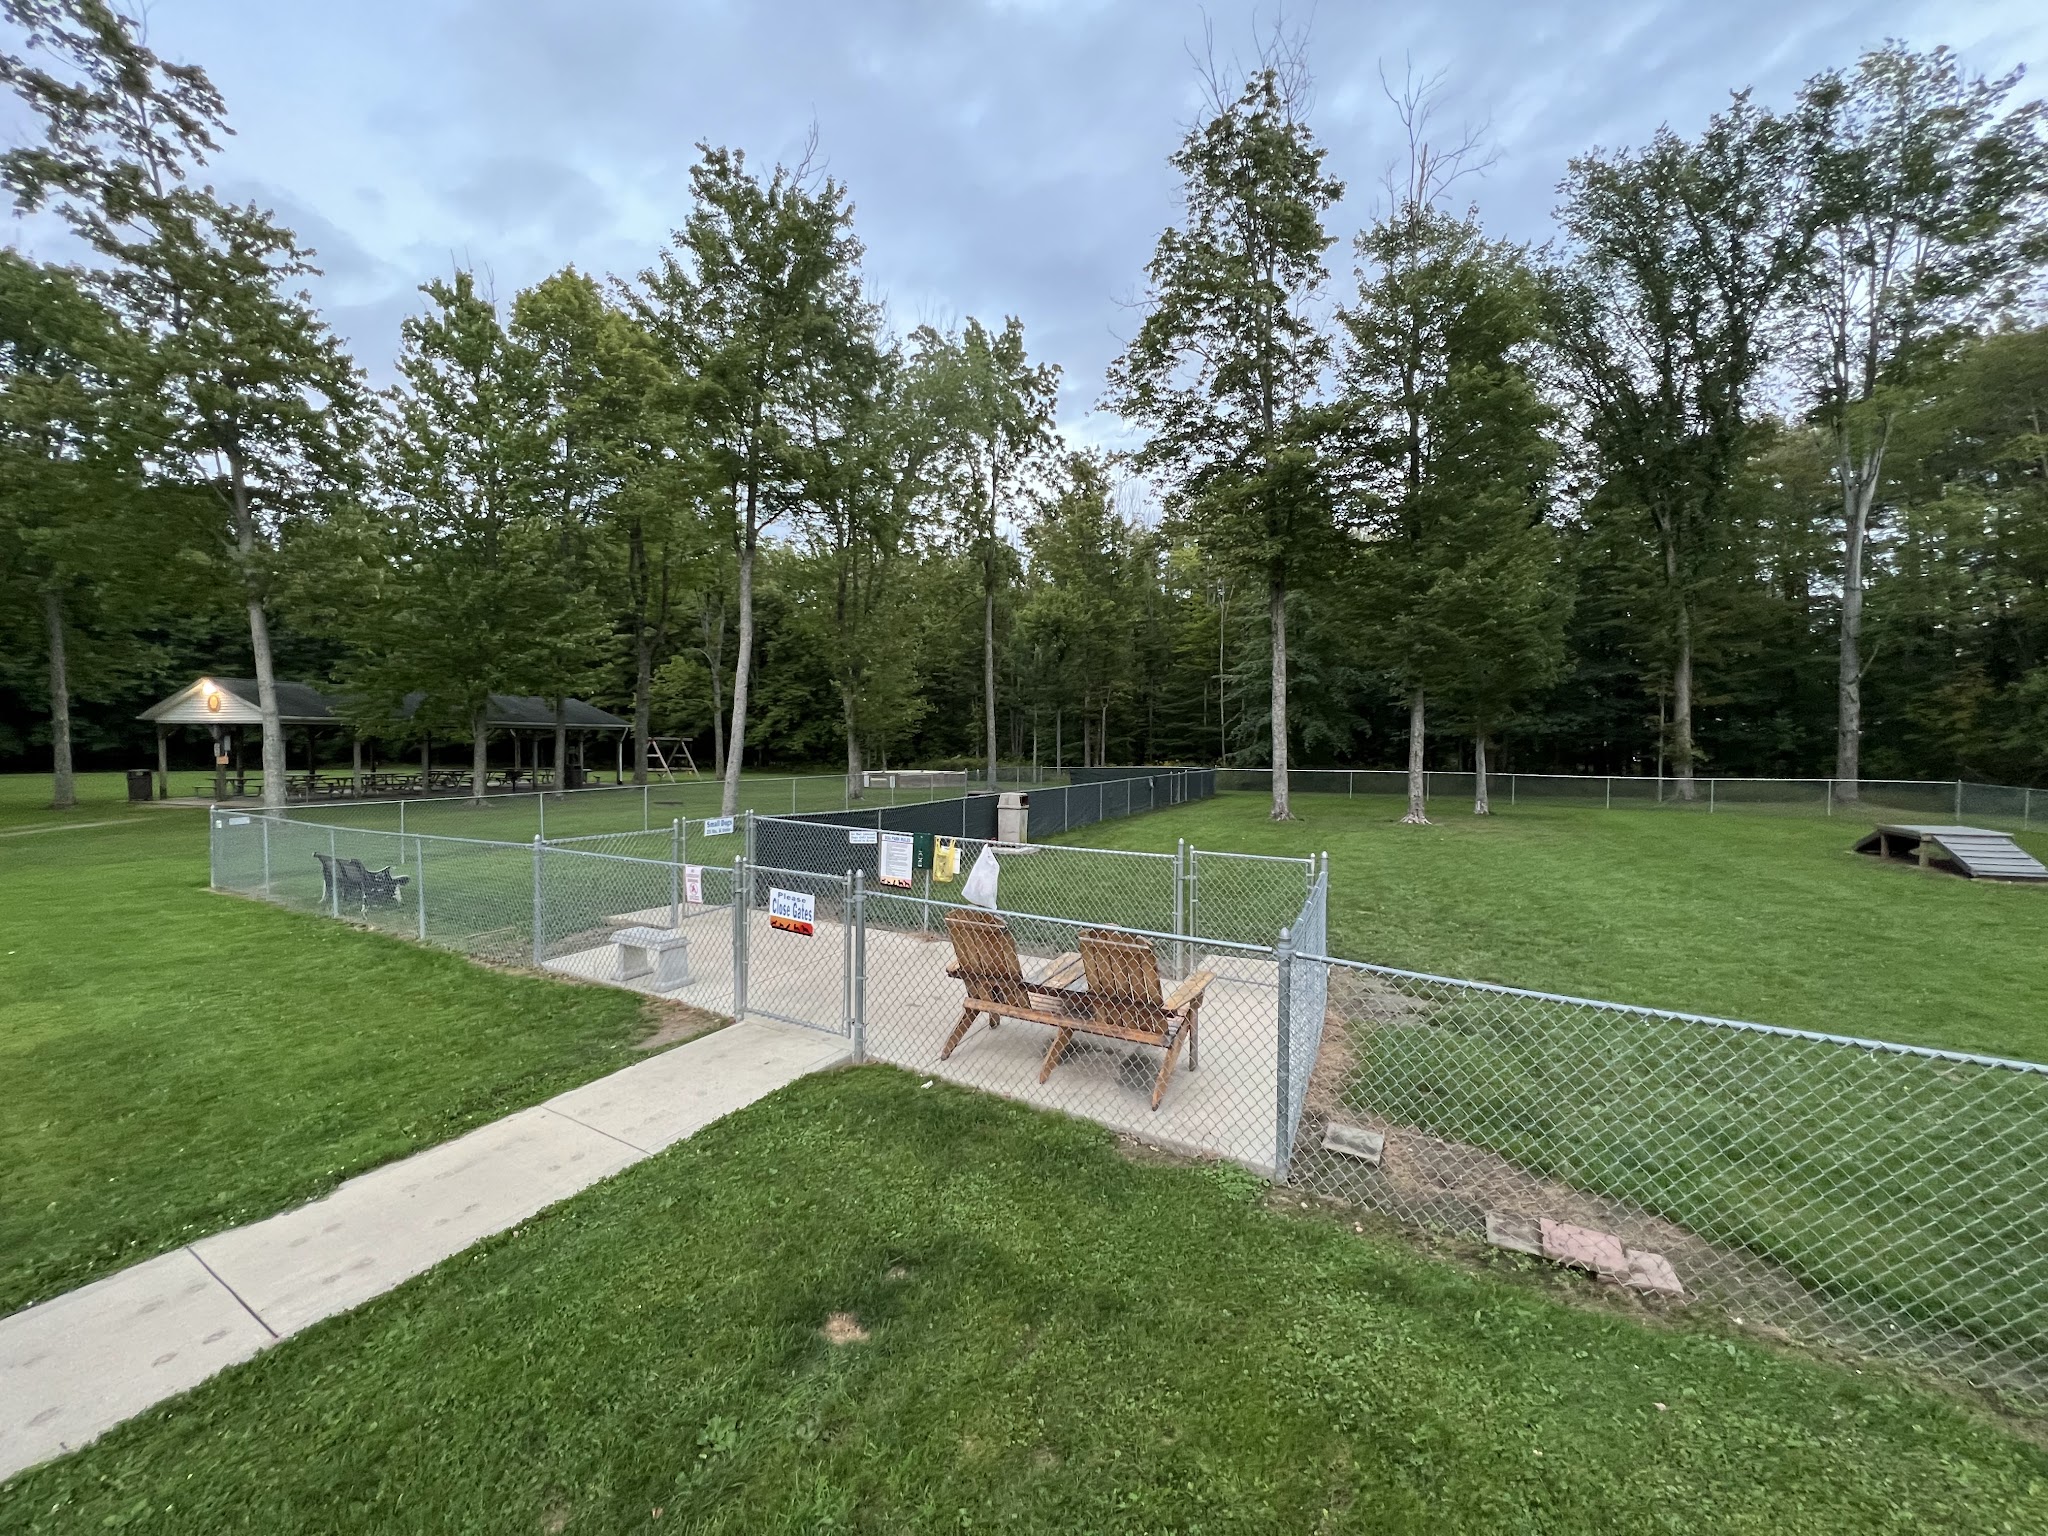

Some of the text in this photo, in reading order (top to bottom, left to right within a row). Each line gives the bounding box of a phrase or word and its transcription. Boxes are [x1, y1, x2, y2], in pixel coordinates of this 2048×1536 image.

[707, 819, 733, 828] Small Dogs
[777, 891, 807, 904] Please
[772, 897, 813, 922] Close Gates
